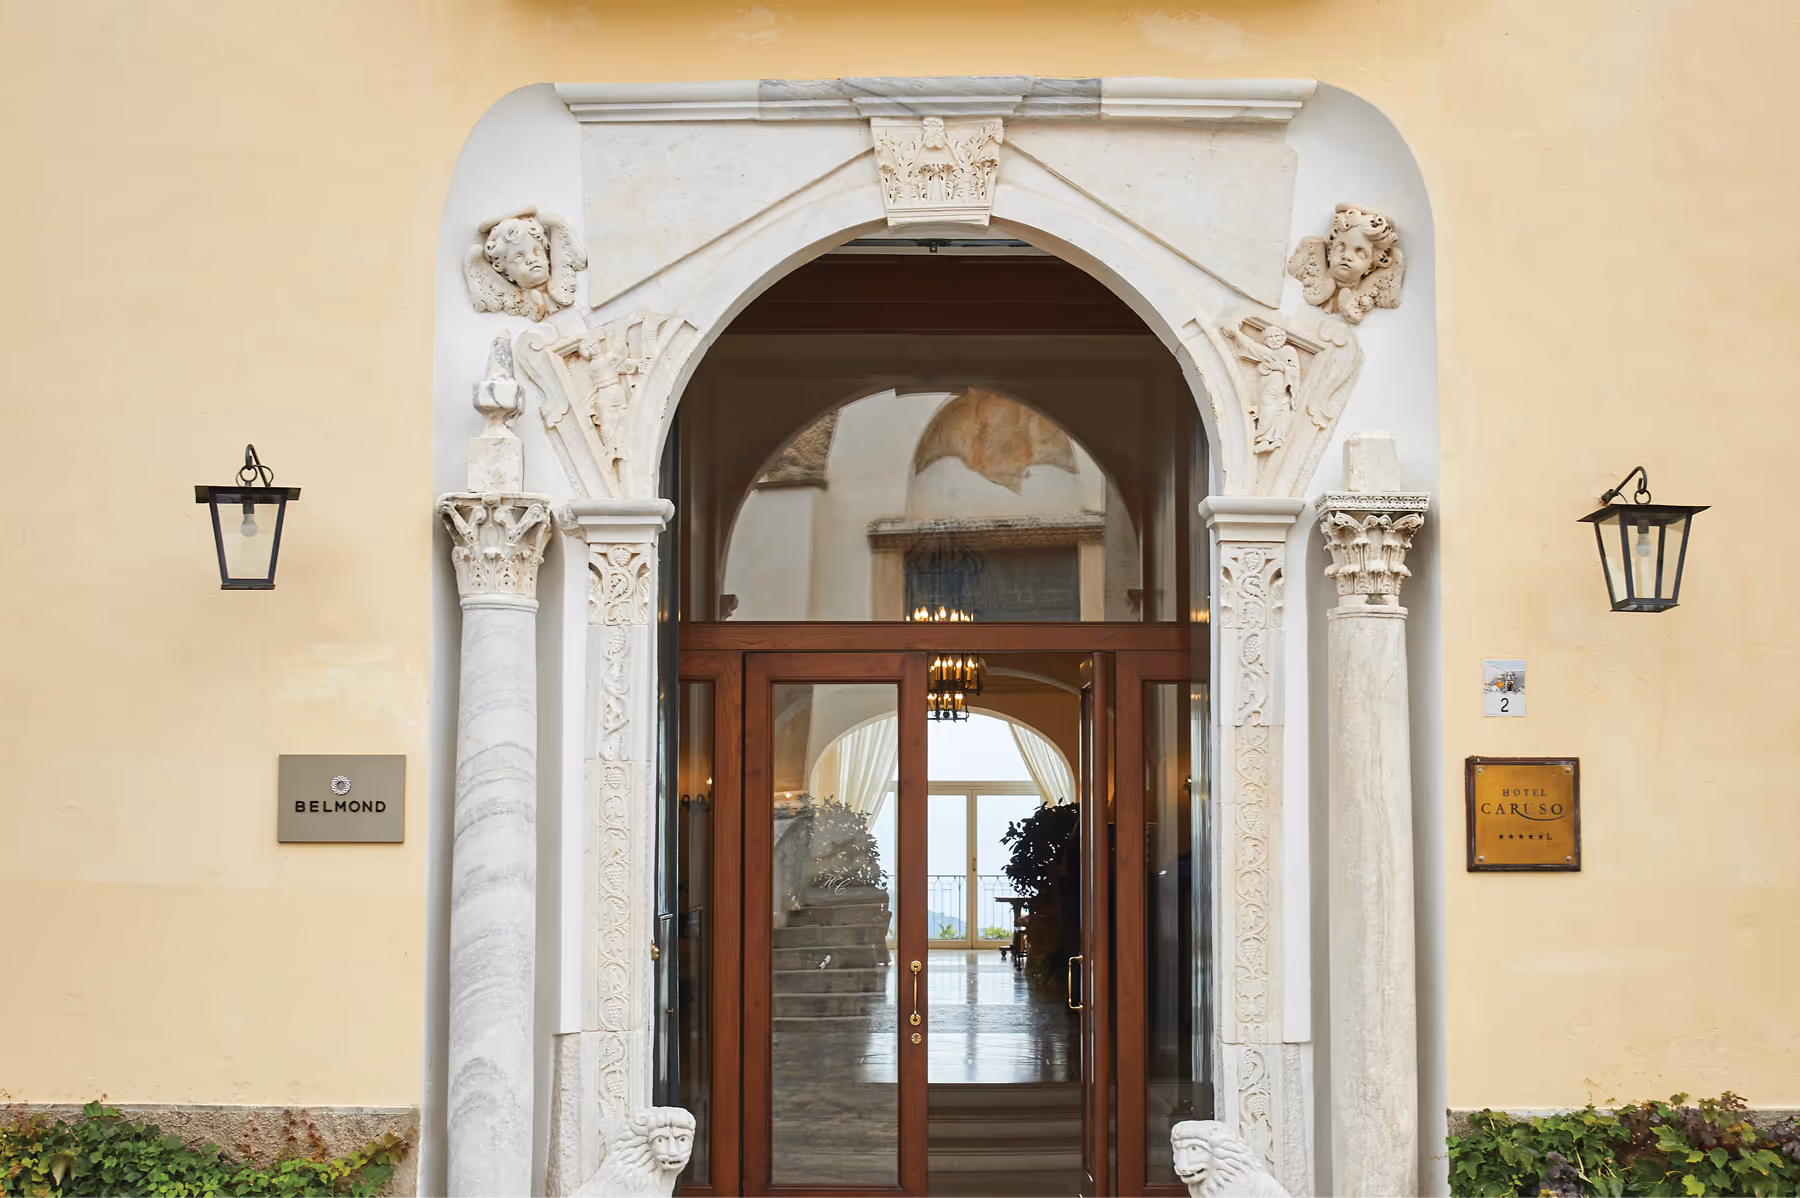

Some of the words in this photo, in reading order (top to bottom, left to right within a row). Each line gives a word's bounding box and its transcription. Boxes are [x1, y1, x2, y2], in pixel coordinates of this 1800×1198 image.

[1500, 697, 1509, 712] 2
[1502, 788, 1547, 797] HOTEL
[294, 800, 386, 813] BELMOND
[1481, 803, 1566, 821] CARUSO
